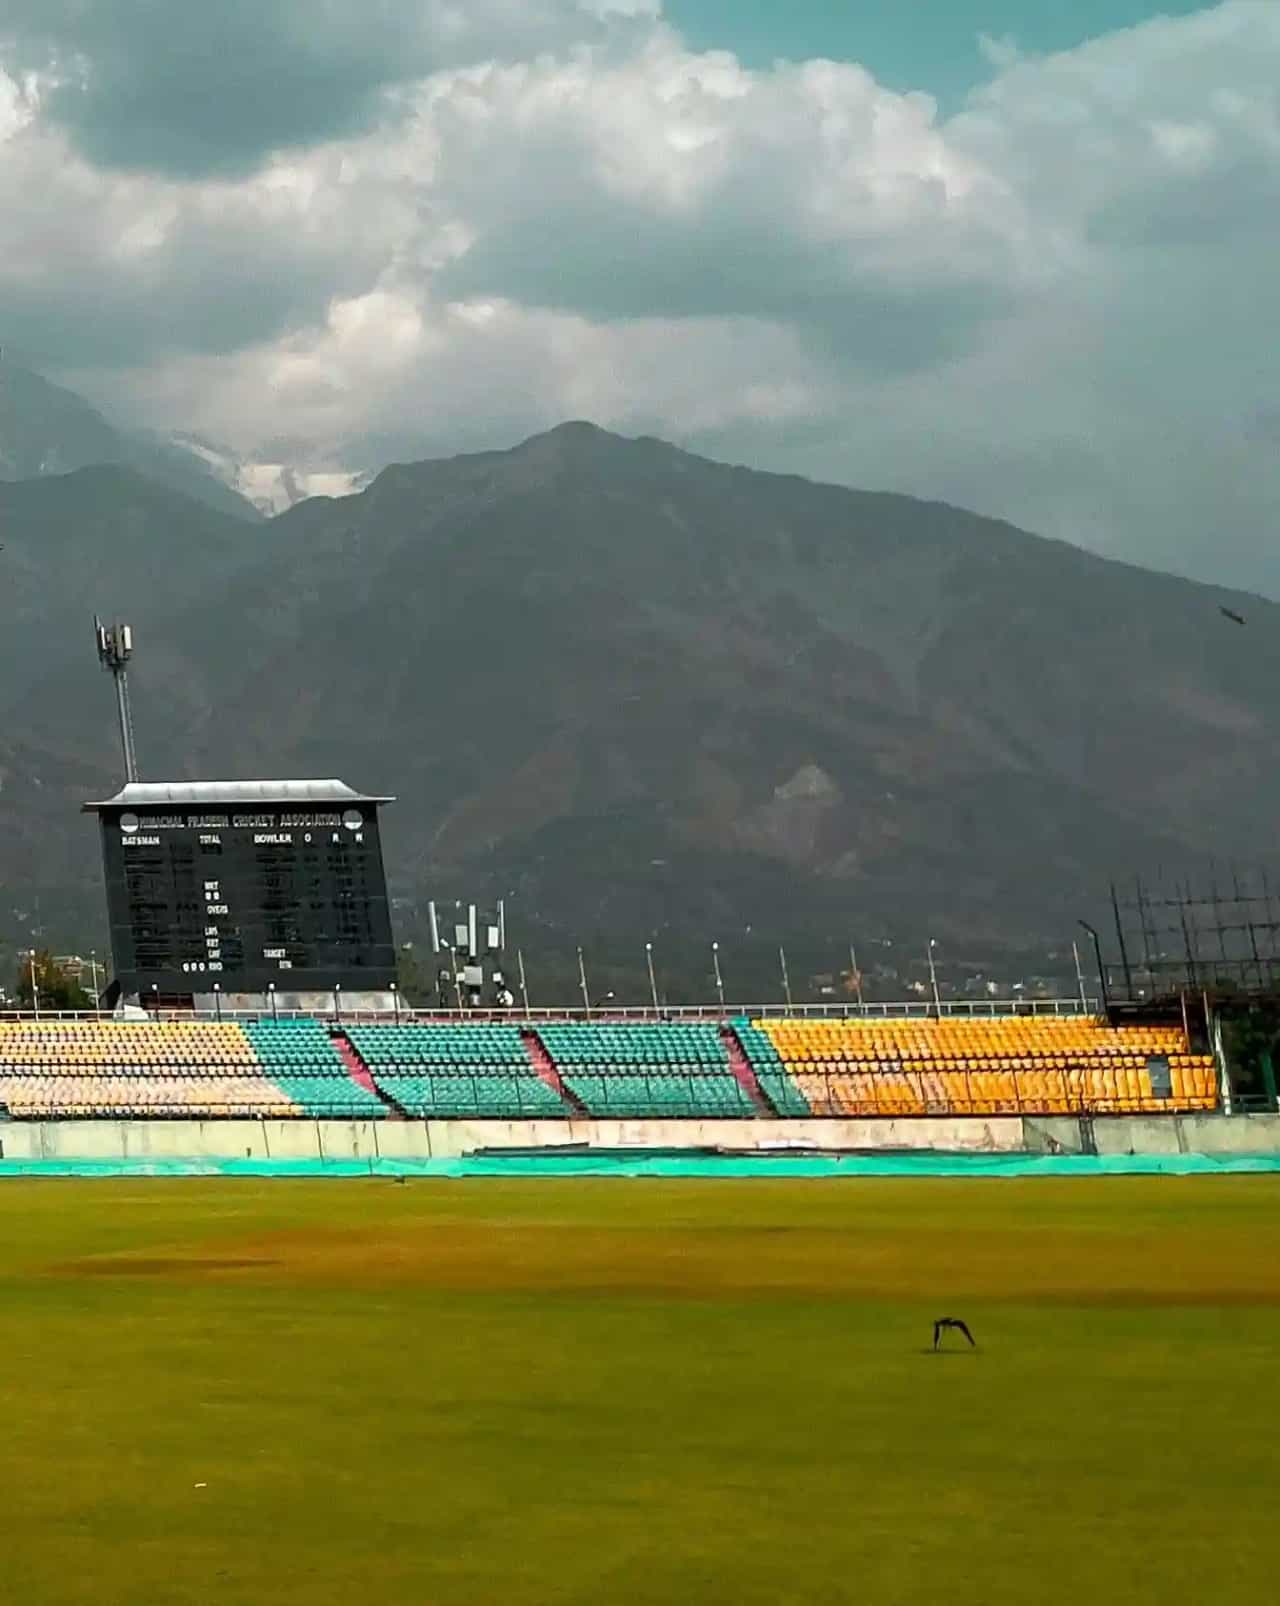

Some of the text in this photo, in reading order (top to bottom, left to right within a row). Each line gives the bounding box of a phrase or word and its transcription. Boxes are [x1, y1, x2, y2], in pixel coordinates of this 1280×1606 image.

[139, 813, 341, 829] HIMACHAL PRADESH CRICKET ASSOCIATION
[121, 835, 161, 846] BATSMAN
[199, 834, 222, 844] TOTAL
[254, 832, 293, 844] BOWLER
